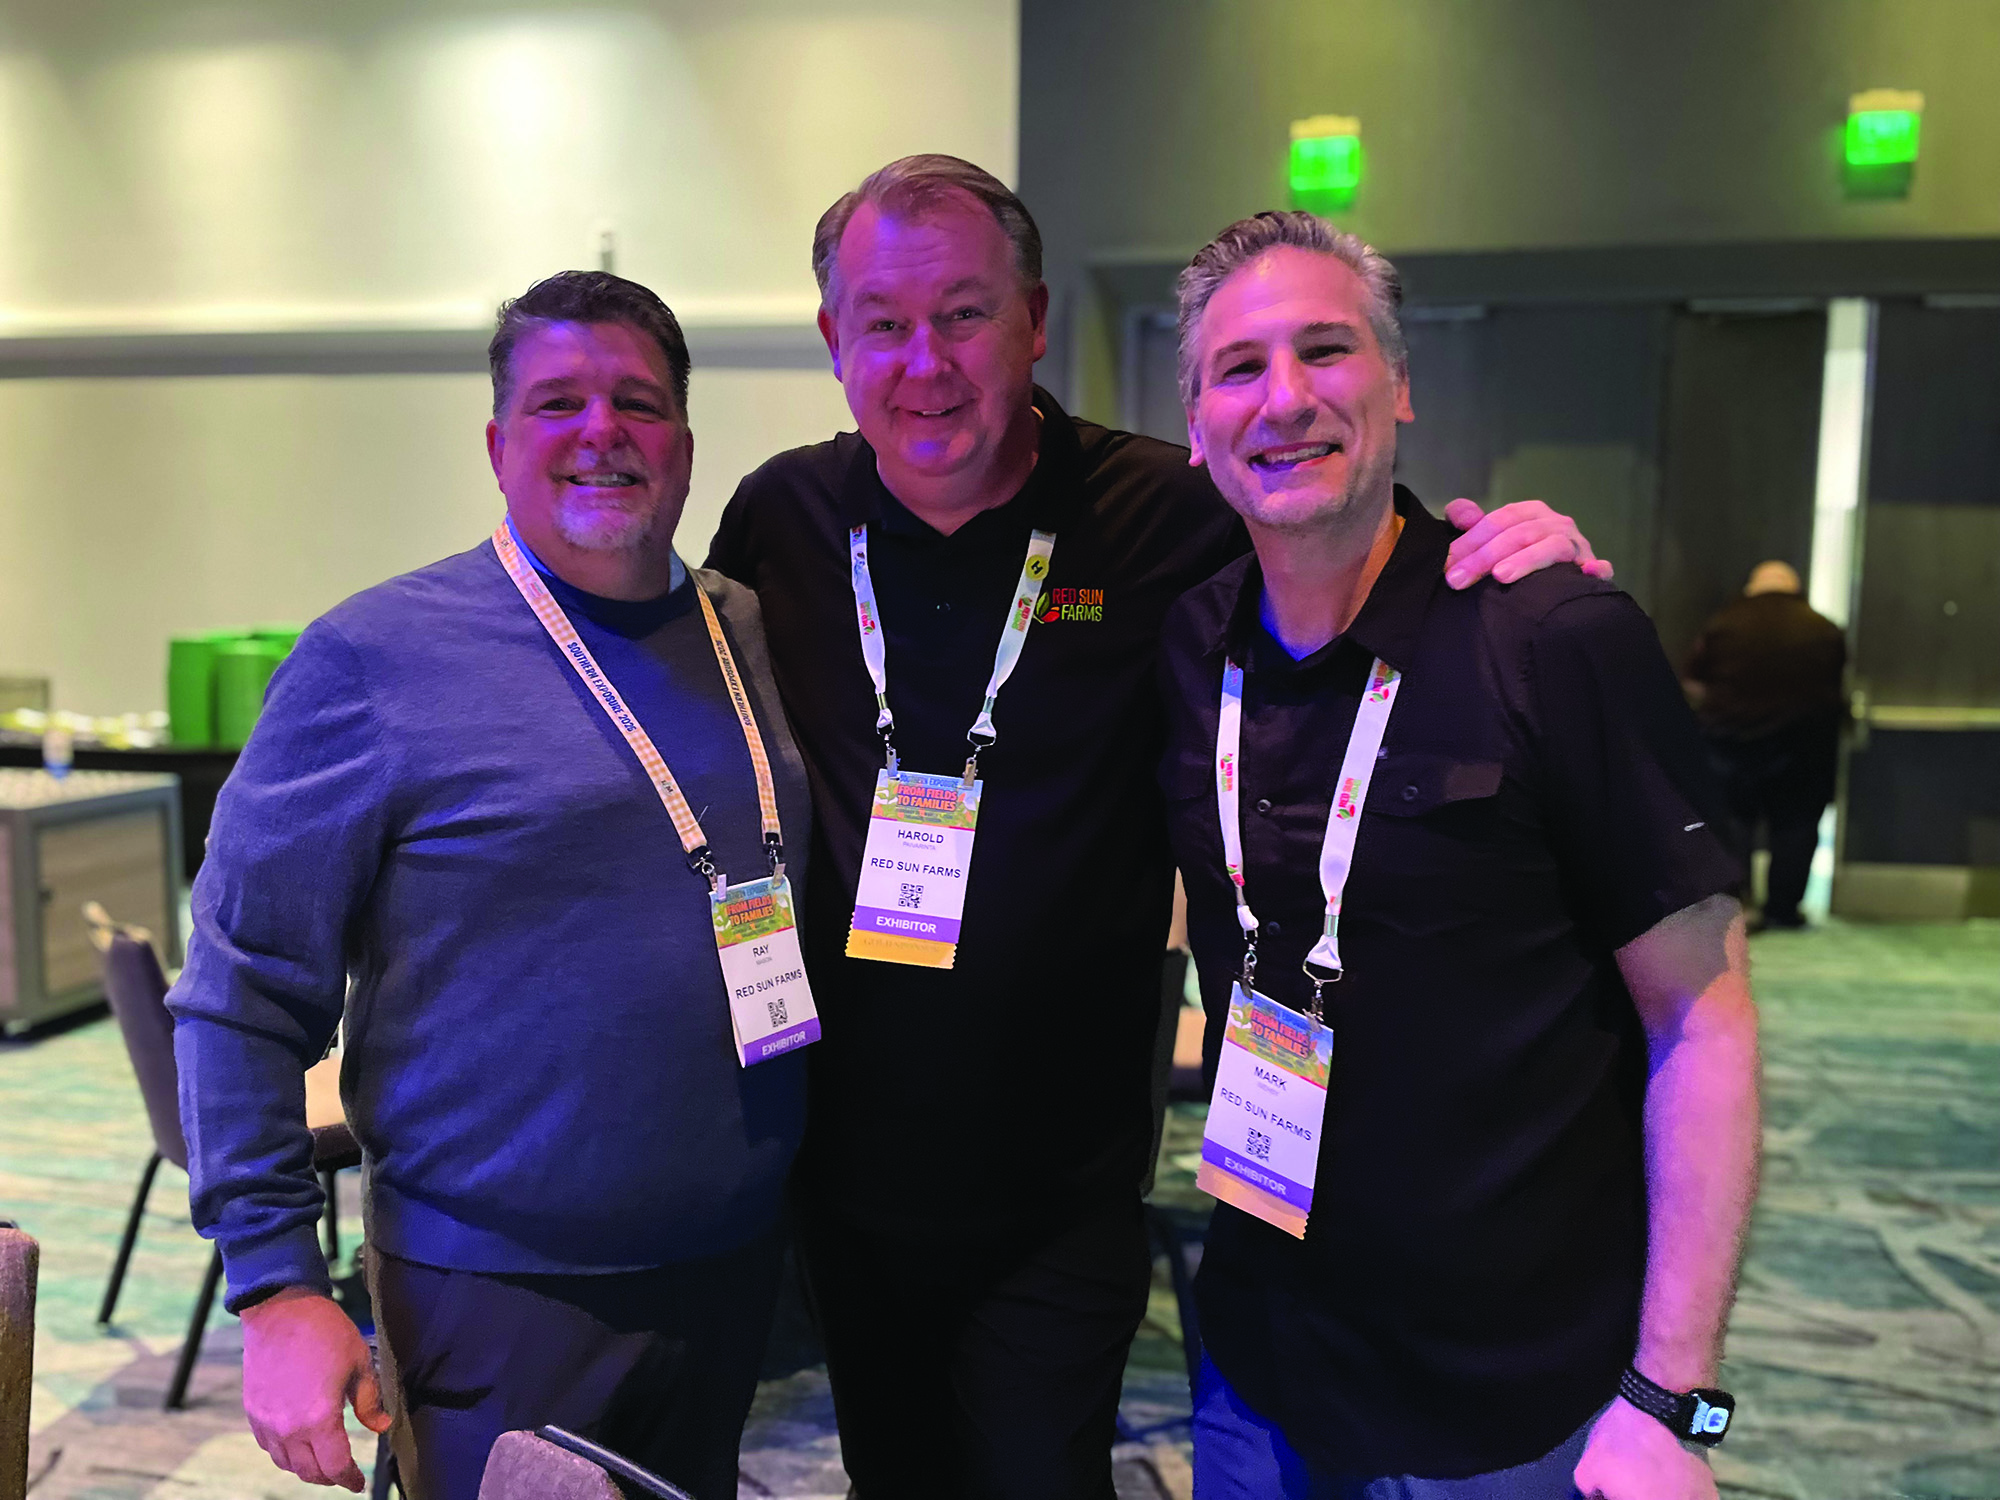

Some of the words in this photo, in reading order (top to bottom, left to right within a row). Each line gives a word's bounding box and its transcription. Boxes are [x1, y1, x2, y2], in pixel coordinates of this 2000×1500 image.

[1052, 588, 1076, 605] RED
[1078, 588, 1104, 606] SUN
[1061, 605, 1103, 622] FARMS
[566, 642, 599, 679] SOUTHERN
[592, 678, 624, 715] EXPOSURE
[721, 658, 740, 690] EXPOSURE
[733, 692, 753, 726] SOUTHERN
[898, 785, 925, 797] FROM
[926, 788, 957, 801] FIELDS
[898, 795, 910, 806] TO
[910, 797, 956, 811] FAMILIES
[897, 829, 944, 844] HAROLD
[871, 857, 894, 869] RED
[896, 861, 919, 873] SUN
[922, 864, 961, 878] FARMS
[727, 900, 748, 915] FROM
[748, 895, 772, 910] FIELDS
[730, 914, 740, 926] TO
[740, 905, 774, 924] FAMILIES
[876, 915, 937, 934] EXHIBITOR
[752, 944, 770, 958] RAY
[735, 986, 755, 999] RED
[756, 980, 775, 993] SUN
[775, 969, 803, 986] FARMS
[1251, 1009, 1278, 1030] FROM
[761, 1030, 806, 1056] EXHIBITOR
[1251, 1021, 1263, 1036] TO
[1263, 1027, 1308, 1058] FAMILIES
[1254, 1066, 1287, 1091] MARK
[1220, 1087, 1243, 1107] RED
[1244, 1100, 1268, 1121] SUN
[1270, 1113, 1312, 1142] FARMS
[1224, 1156, 1287, 1196] EXHIBITOR
